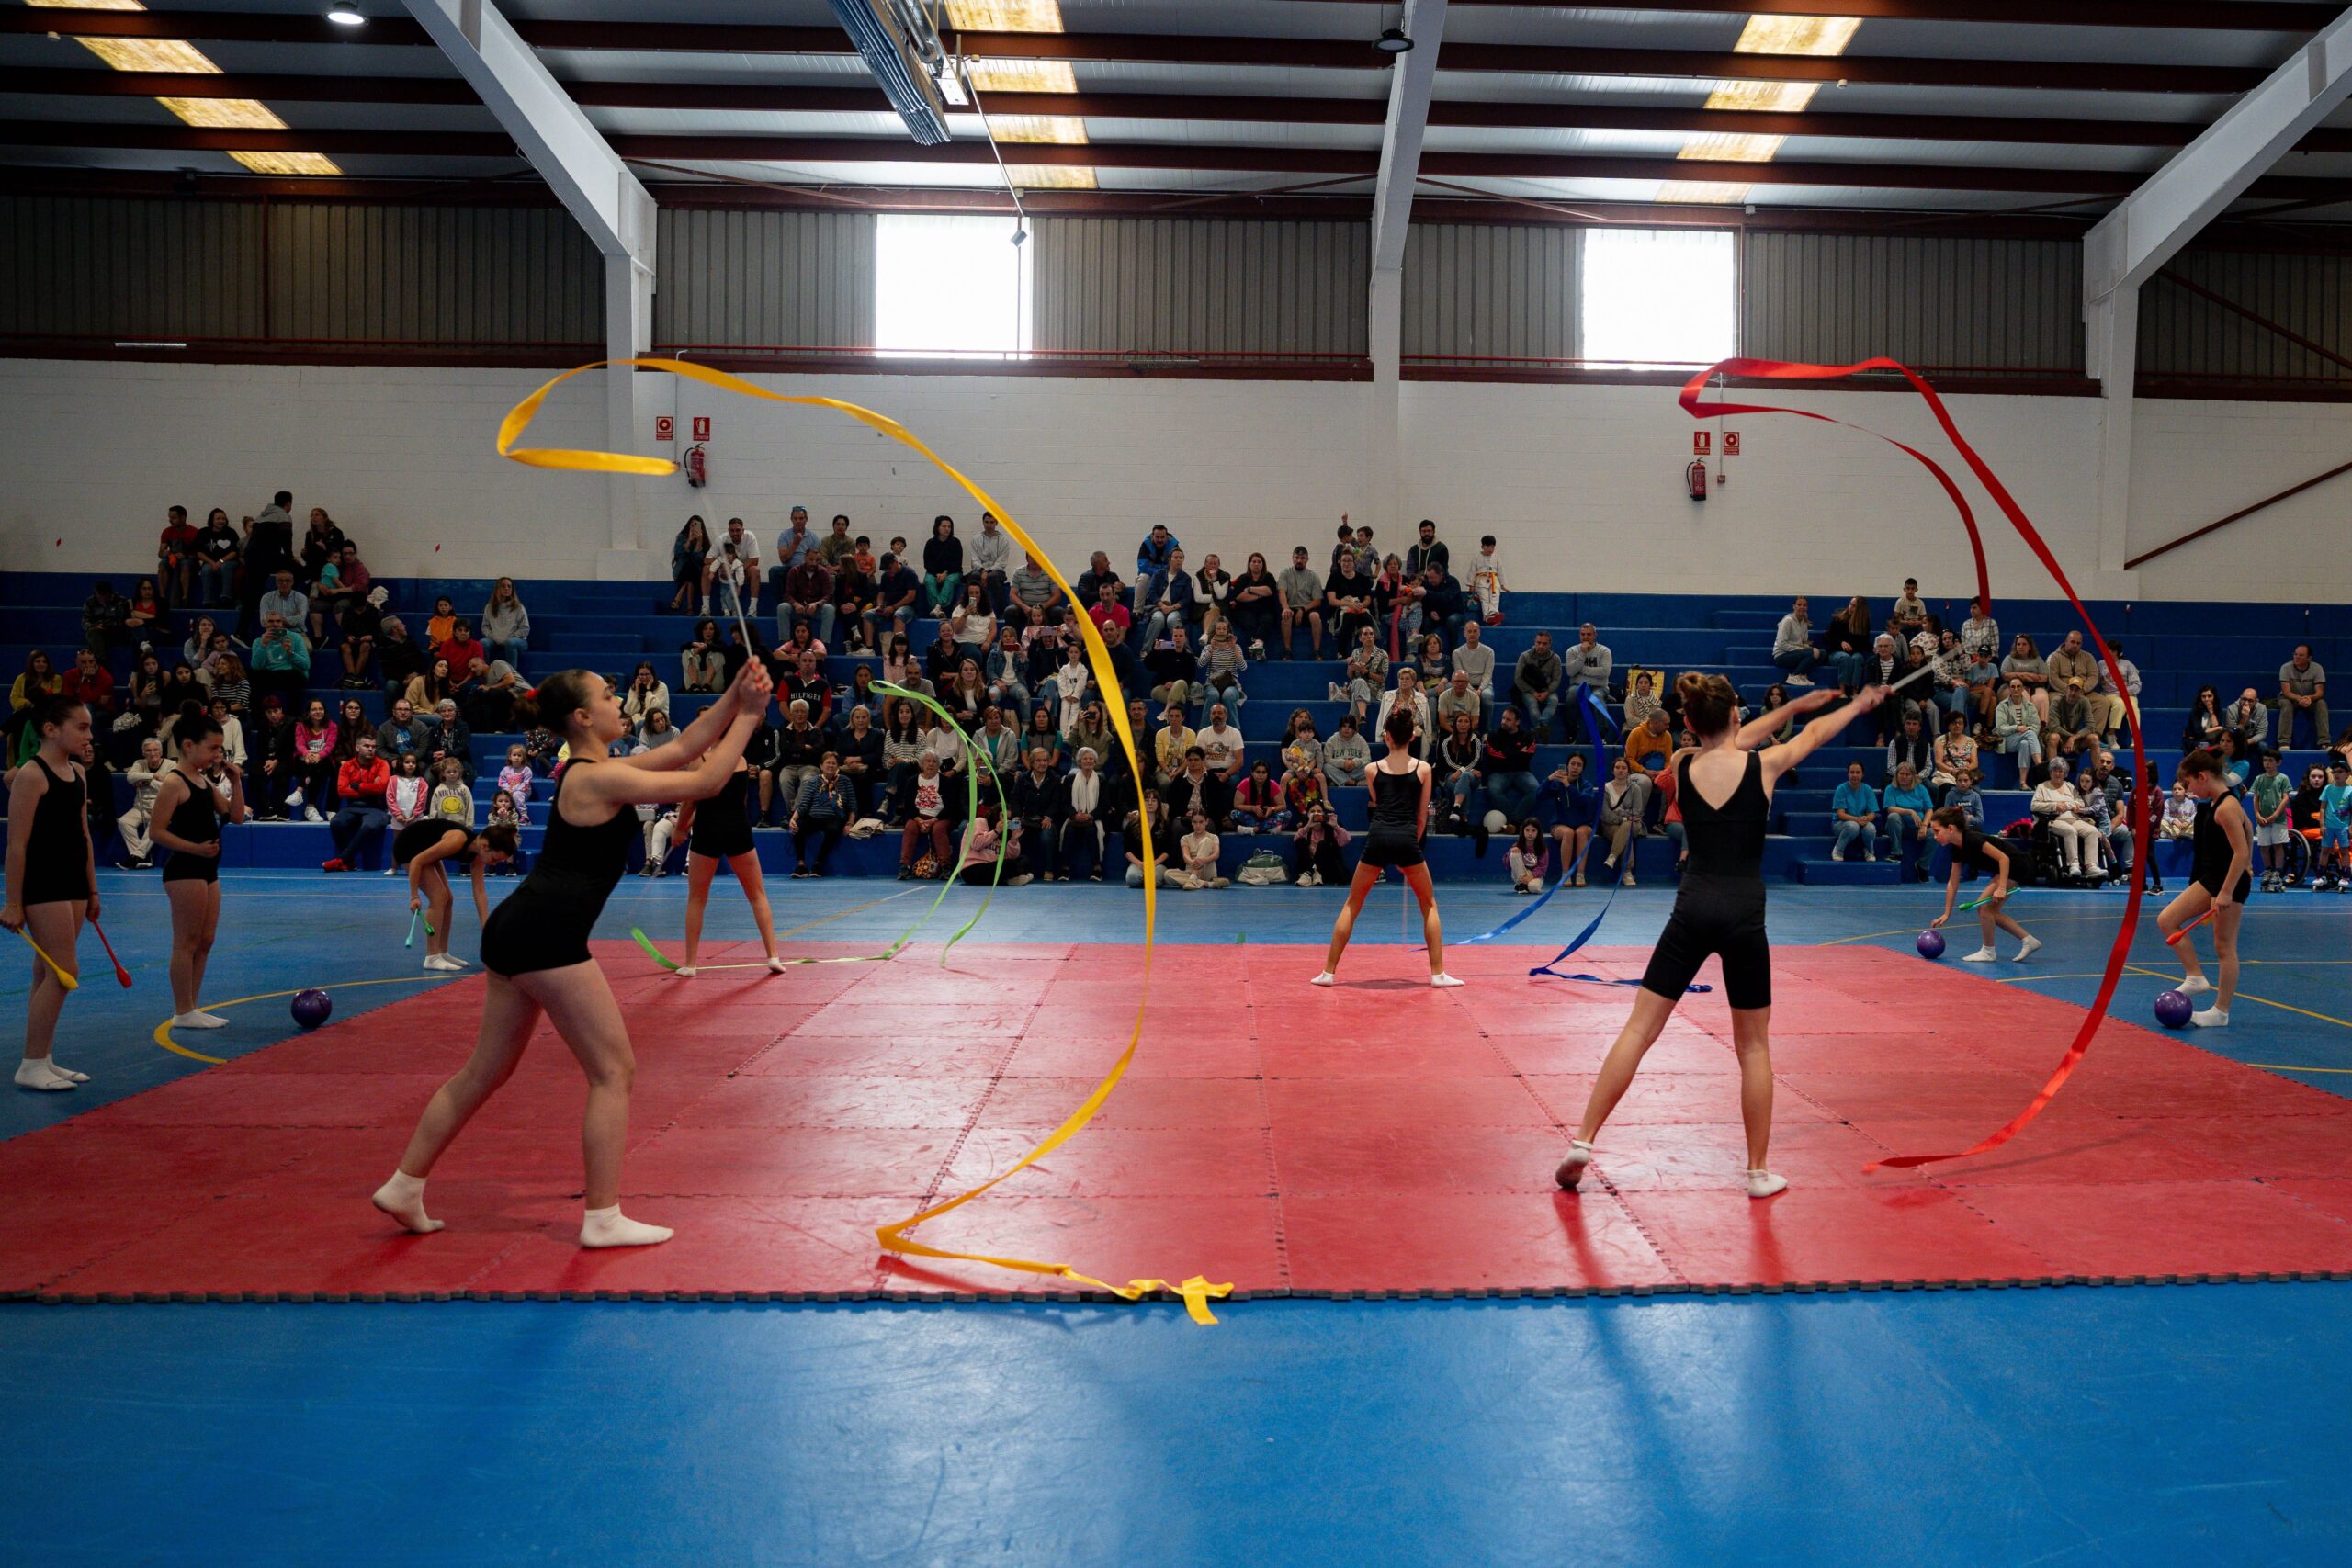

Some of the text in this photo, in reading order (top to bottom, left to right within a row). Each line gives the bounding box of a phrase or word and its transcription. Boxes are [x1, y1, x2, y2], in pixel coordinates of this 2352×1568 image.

[790, 692, 822, 701] HILFIGER
[1332, 748, 1362, 759] NEW YORK
